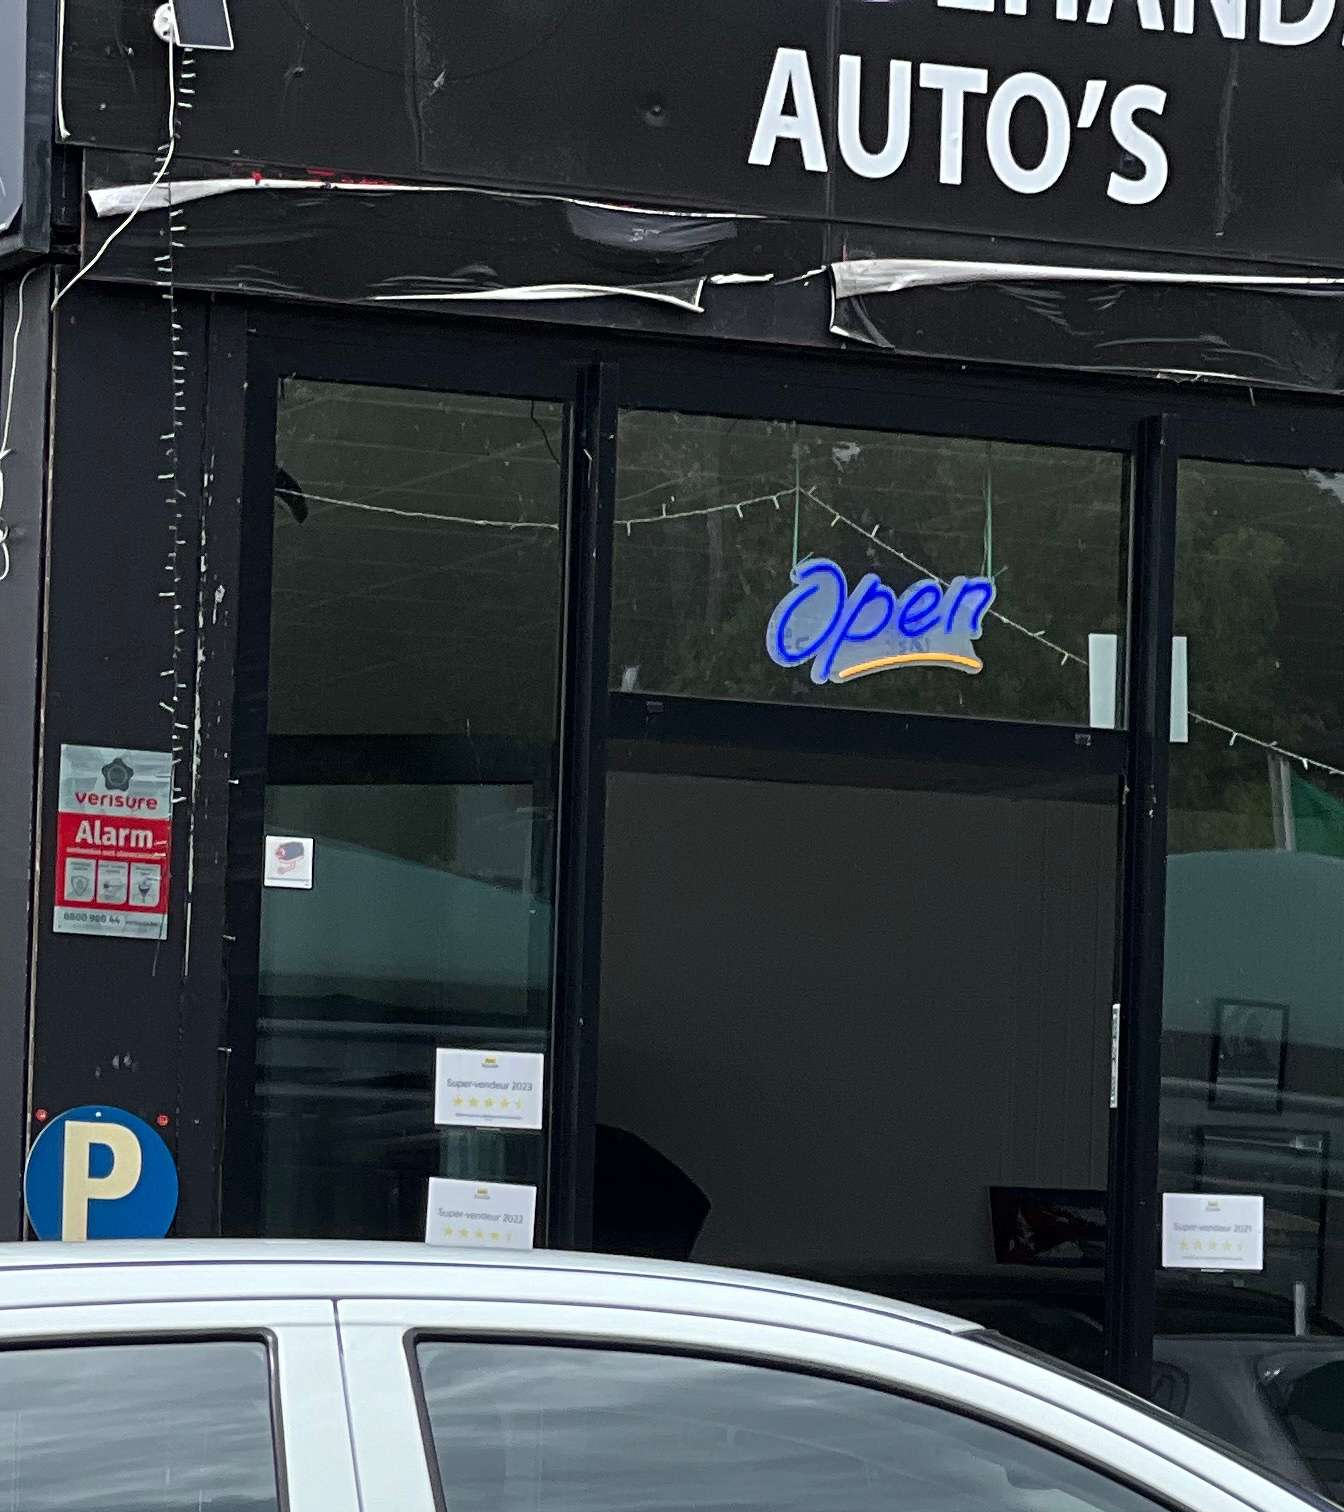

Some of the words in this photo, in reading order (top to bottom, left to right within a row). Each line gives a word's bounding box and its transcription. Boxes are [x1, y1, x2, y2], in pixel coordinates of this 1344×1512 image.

[748, 47, 1168, 205] AUTO'S
[776, 562, 993, 680] Open
[74, 791, 159, 810] verisure
[75, 820, 153, 849] Alarm
[62, 1120, 142, 1242] P
